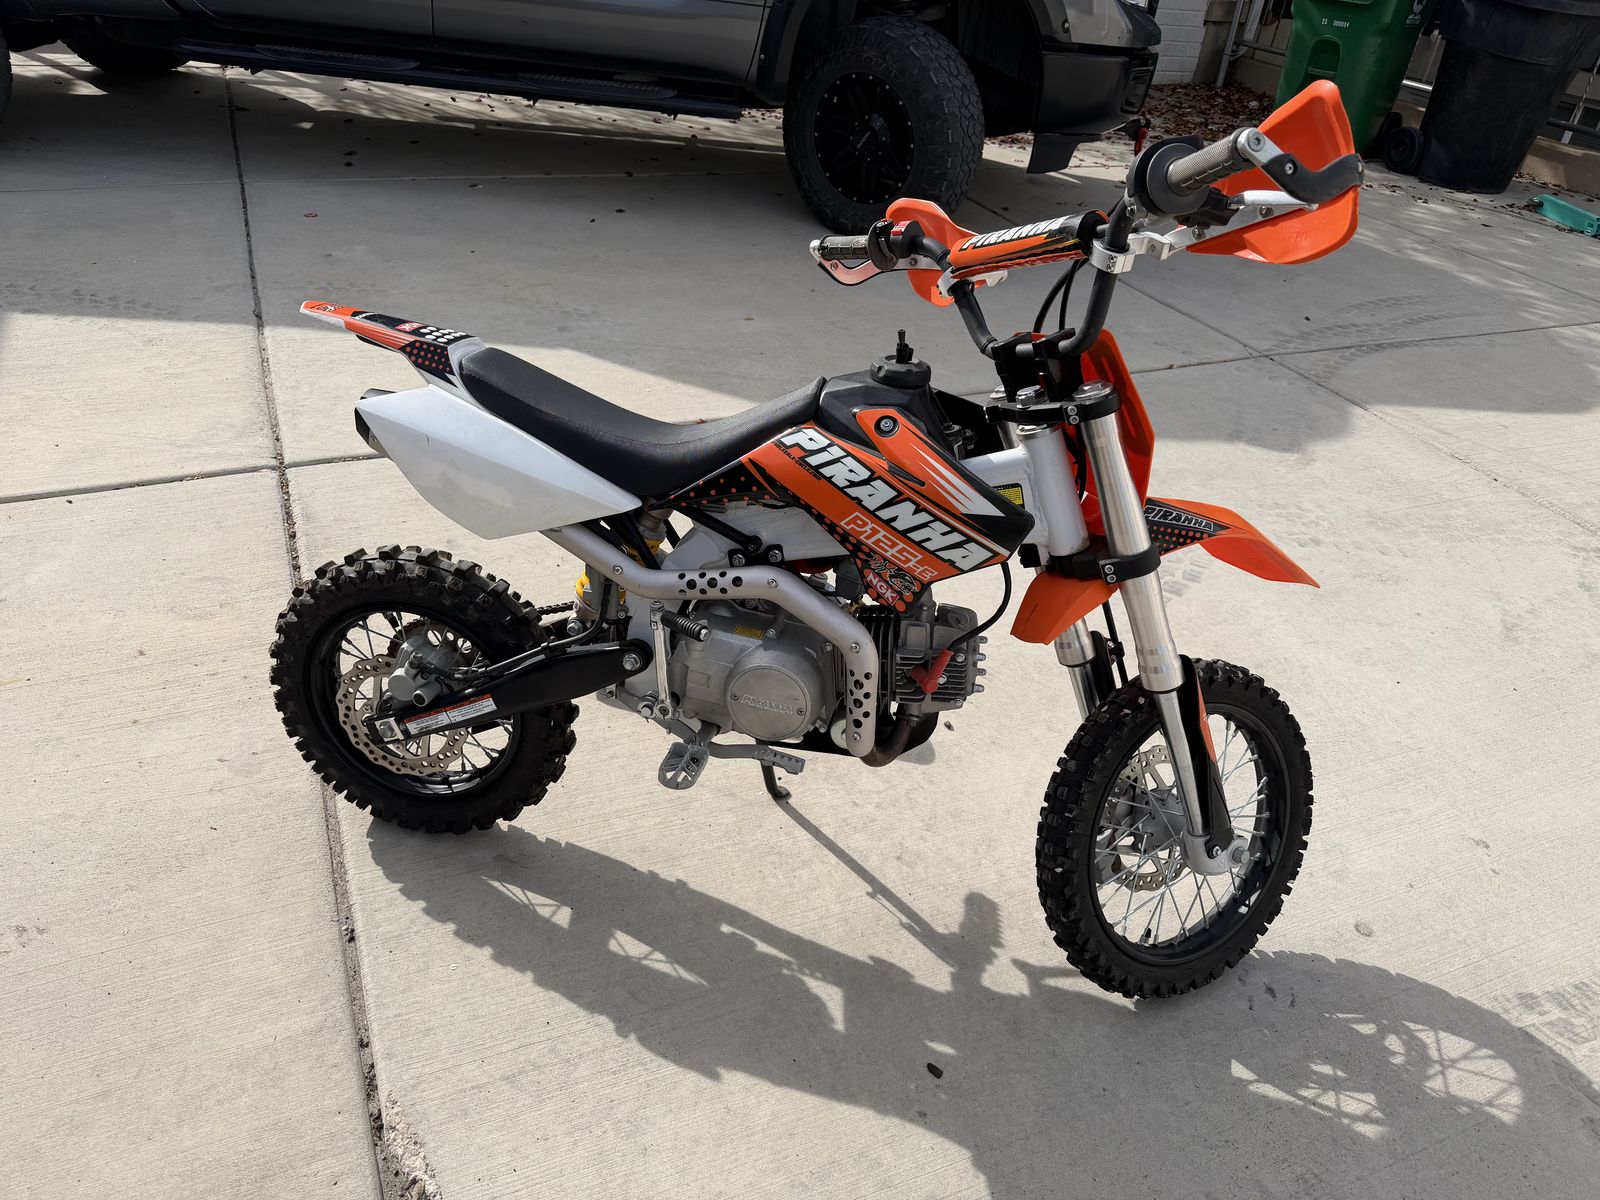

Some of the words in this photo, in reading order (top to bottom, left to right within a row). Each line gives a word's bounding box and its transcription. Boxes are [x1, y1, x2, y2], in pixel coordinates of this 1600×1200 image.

[960, 214, 1072, 250] PIRANHA
[779, 428, 996, 572] PIRANHA
[1143, 505, 1214, 532] PIRANHA
[867, 572, 899, 603] NGK
[740, 694, 794, 715] PIRANHA
